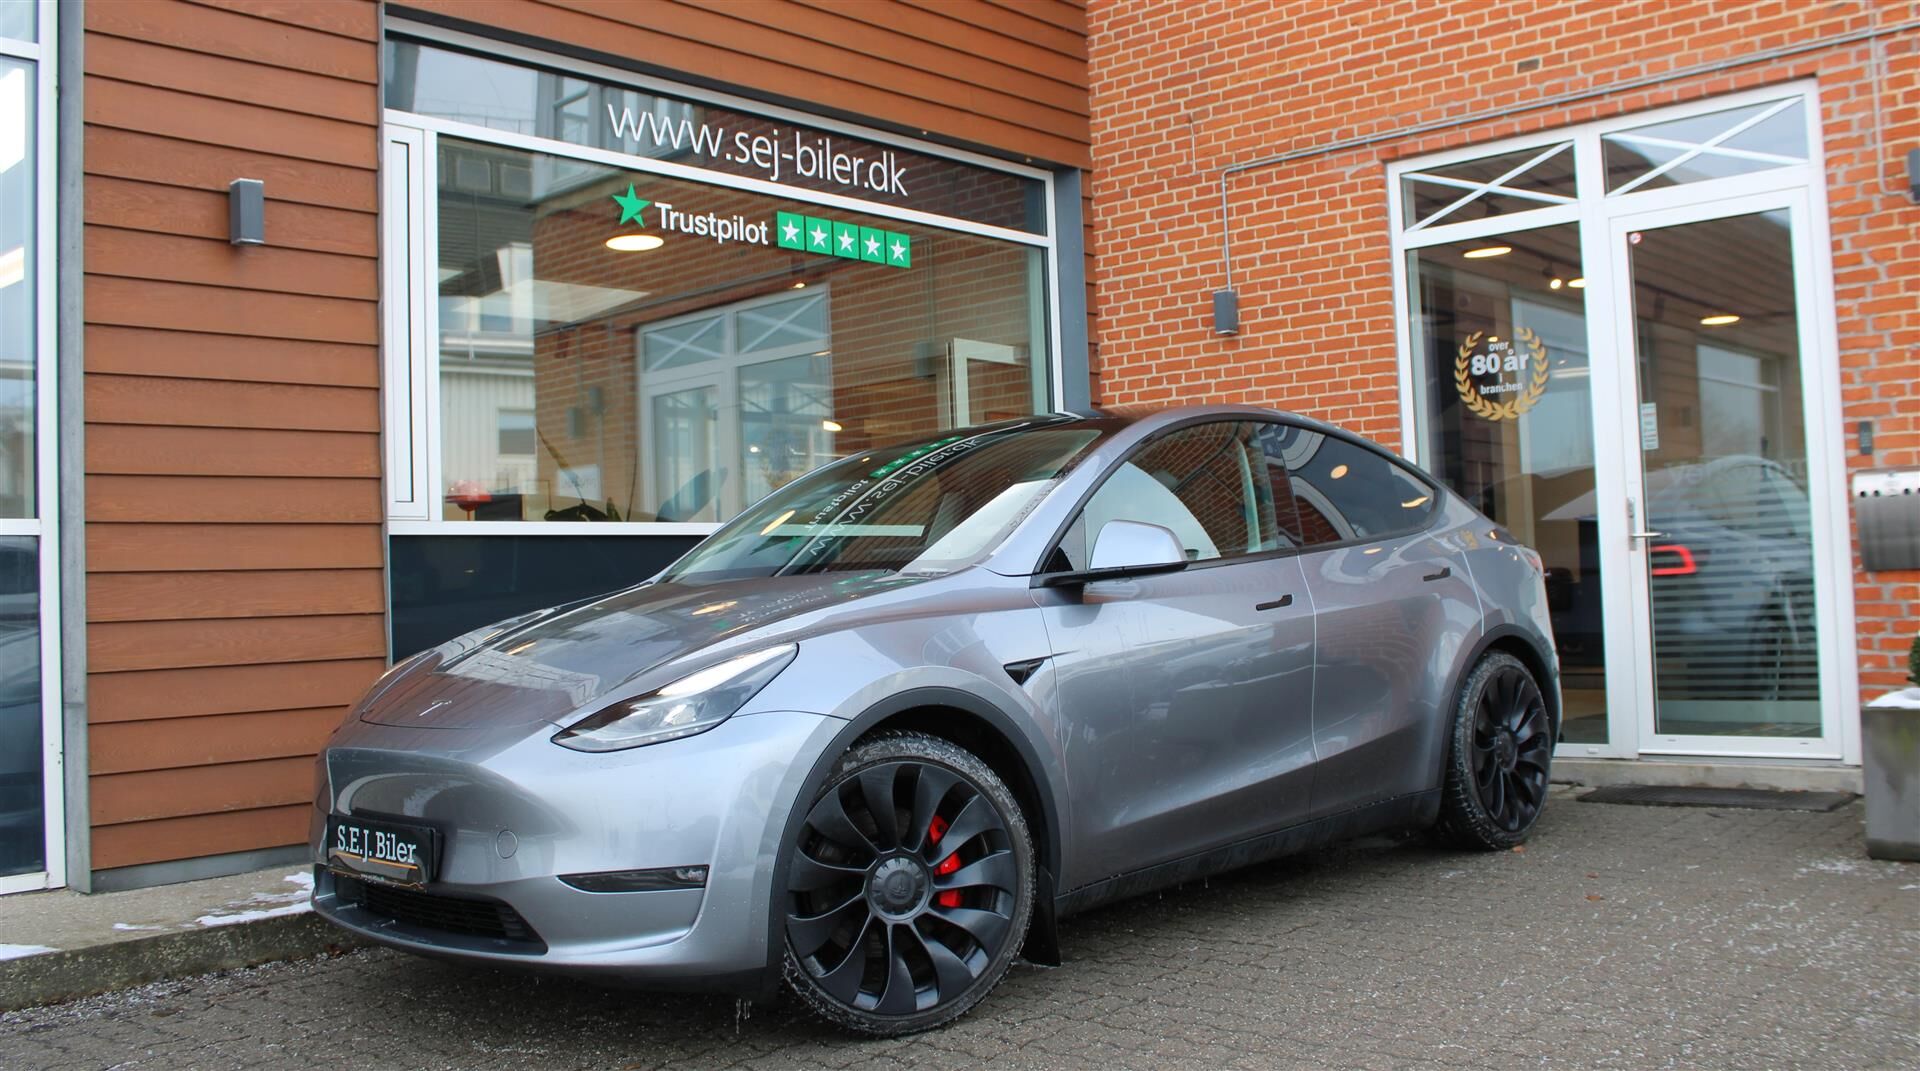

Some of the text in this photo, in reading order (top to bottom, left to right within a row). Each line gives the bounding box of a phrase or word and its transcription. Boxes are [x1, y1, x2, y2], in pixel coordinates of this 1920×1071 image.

[608, 104, 907, 197] www.sej-biler.dk
[655, 202, 768, 245] Trustpilot
[1472, 349, 1529, 375] 80 år
[1489, 341, 1509, 351] over
[1480, 382, 1523, 394] branchen
[337, 825, 416, 863] S.E.J. Biler
